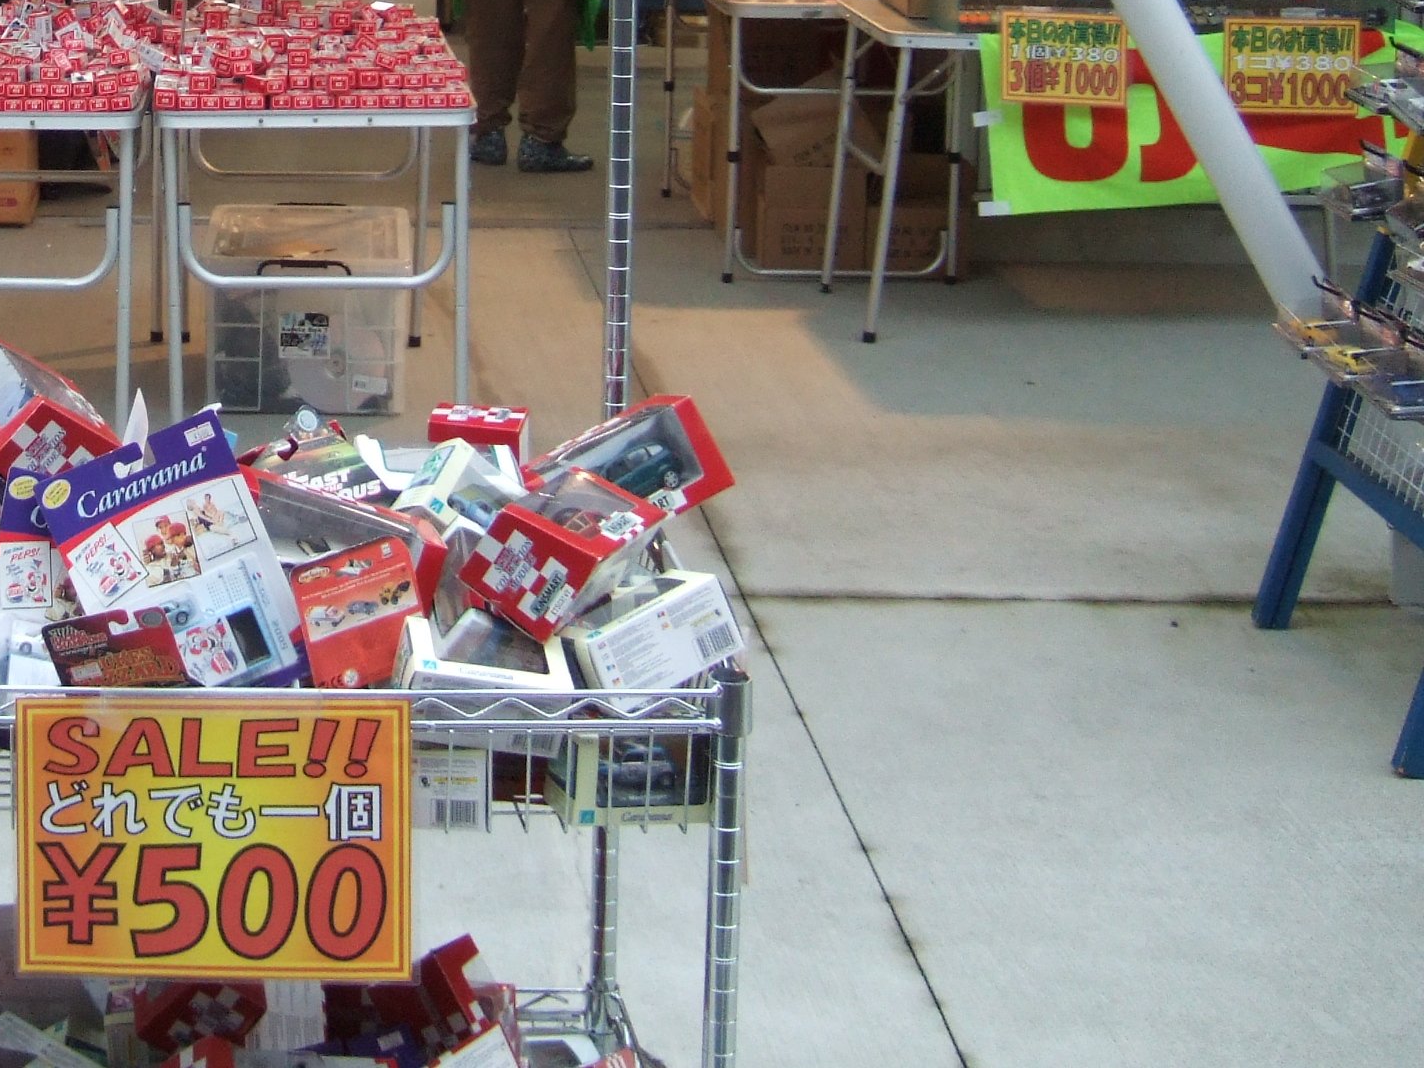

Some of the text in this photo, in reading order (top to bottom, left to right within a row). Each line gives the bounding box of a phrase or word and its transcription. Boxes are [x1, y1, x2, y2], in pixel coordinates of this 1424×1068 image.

[77, 452, 206, 519] Cararama
[42, 716, 383, 780] SALE!!
[39, 781, 382, 842] どれでも一個
[38, 842, 387, 961] ¥500
